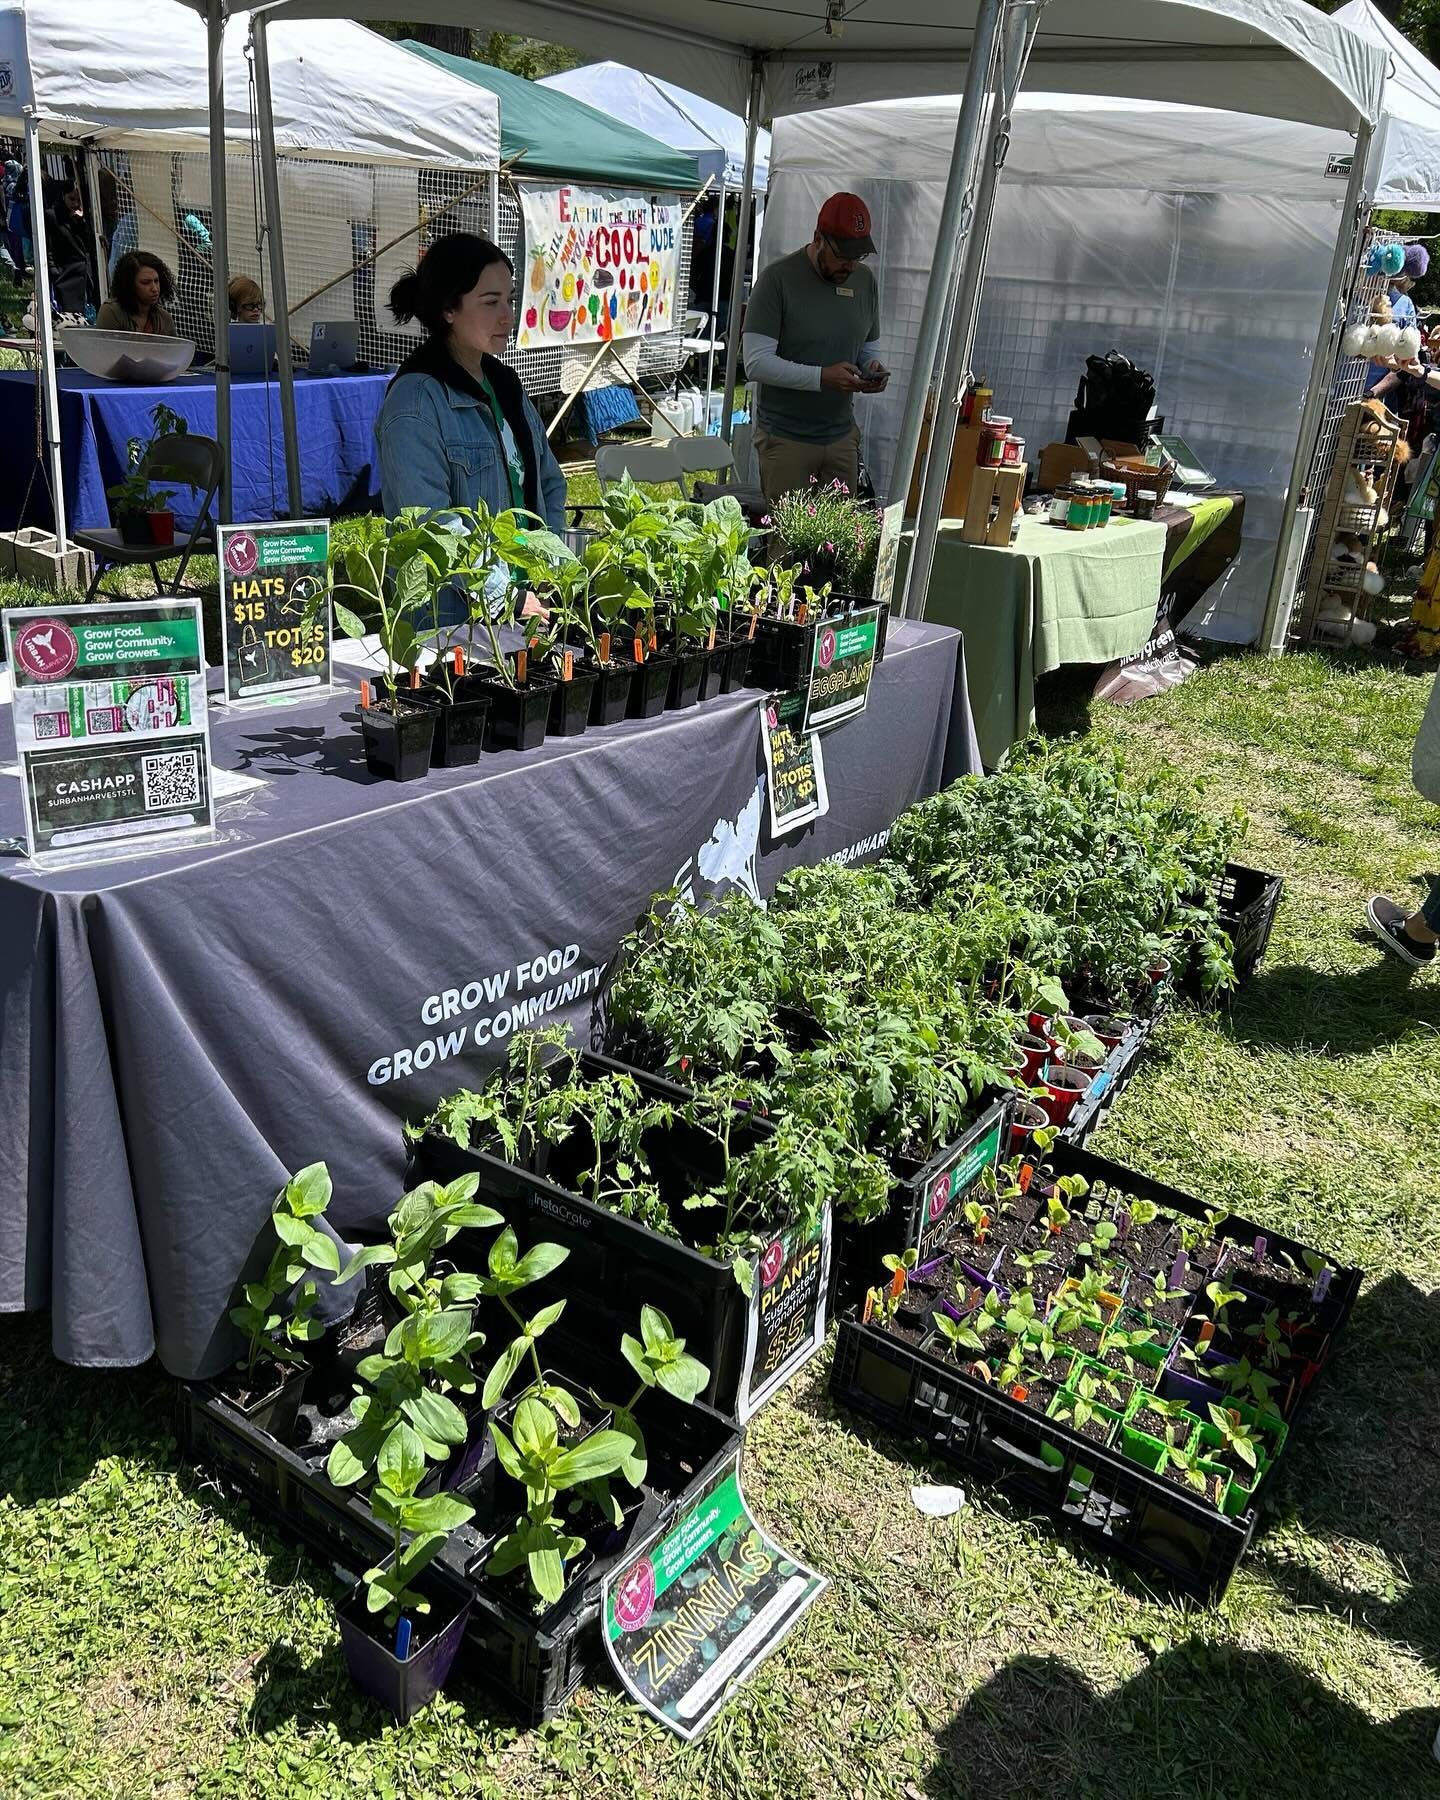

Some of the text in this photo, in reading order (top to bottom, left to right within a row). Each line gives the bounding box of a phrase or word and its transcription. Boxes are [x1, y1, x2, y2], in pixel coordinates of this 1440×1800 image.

[609, 211, 623, 224] THE
[595, 225, 650, 268] COOL
[651, 227, 674, 253] DUDE
[263, 540, 279, 548] Grow
[263, 548, 279, 556] Grow
[263, 556, 280, 564] Grow
[232, 577, 285, 600] HATS
[234, 602, 266, 624] $15
[84, 626, 144, 639] Grow Food.
[85, 635, 176, 650] Grow Community.
[25, 638, 46, 668] URBAN
[86, 648, 160, 662] Grow Growers.
[291, 645, 325, 668] $20
[810, 660, 873, 700] EGGPLANT
[772, 729, 792, 750] HATS
[56, 774, 136, 796] CASHAPP
[48, 789, 137, 807] $URBANHARVESTSTL
[421, 943, 580, 1026] GROW FOOD
[367, 962, 608, 1086] GROW COMMUNITY
[534, 1191, 591, 1228] InstaCrate
[761, 1243, 820, 1314] PLANTS
[764, 1266, 816, 1327] Suggested
[767, 1287, 811, 1335] donation
[765, 1304, 807, 1372] $5
[662, 1532, 681, 1555] Grow
[663, 1544, 682, 1566] Grow
[665, 1555, 685, 1578] Grow
[632, 1540, 773, 1690] ZINNIAS
